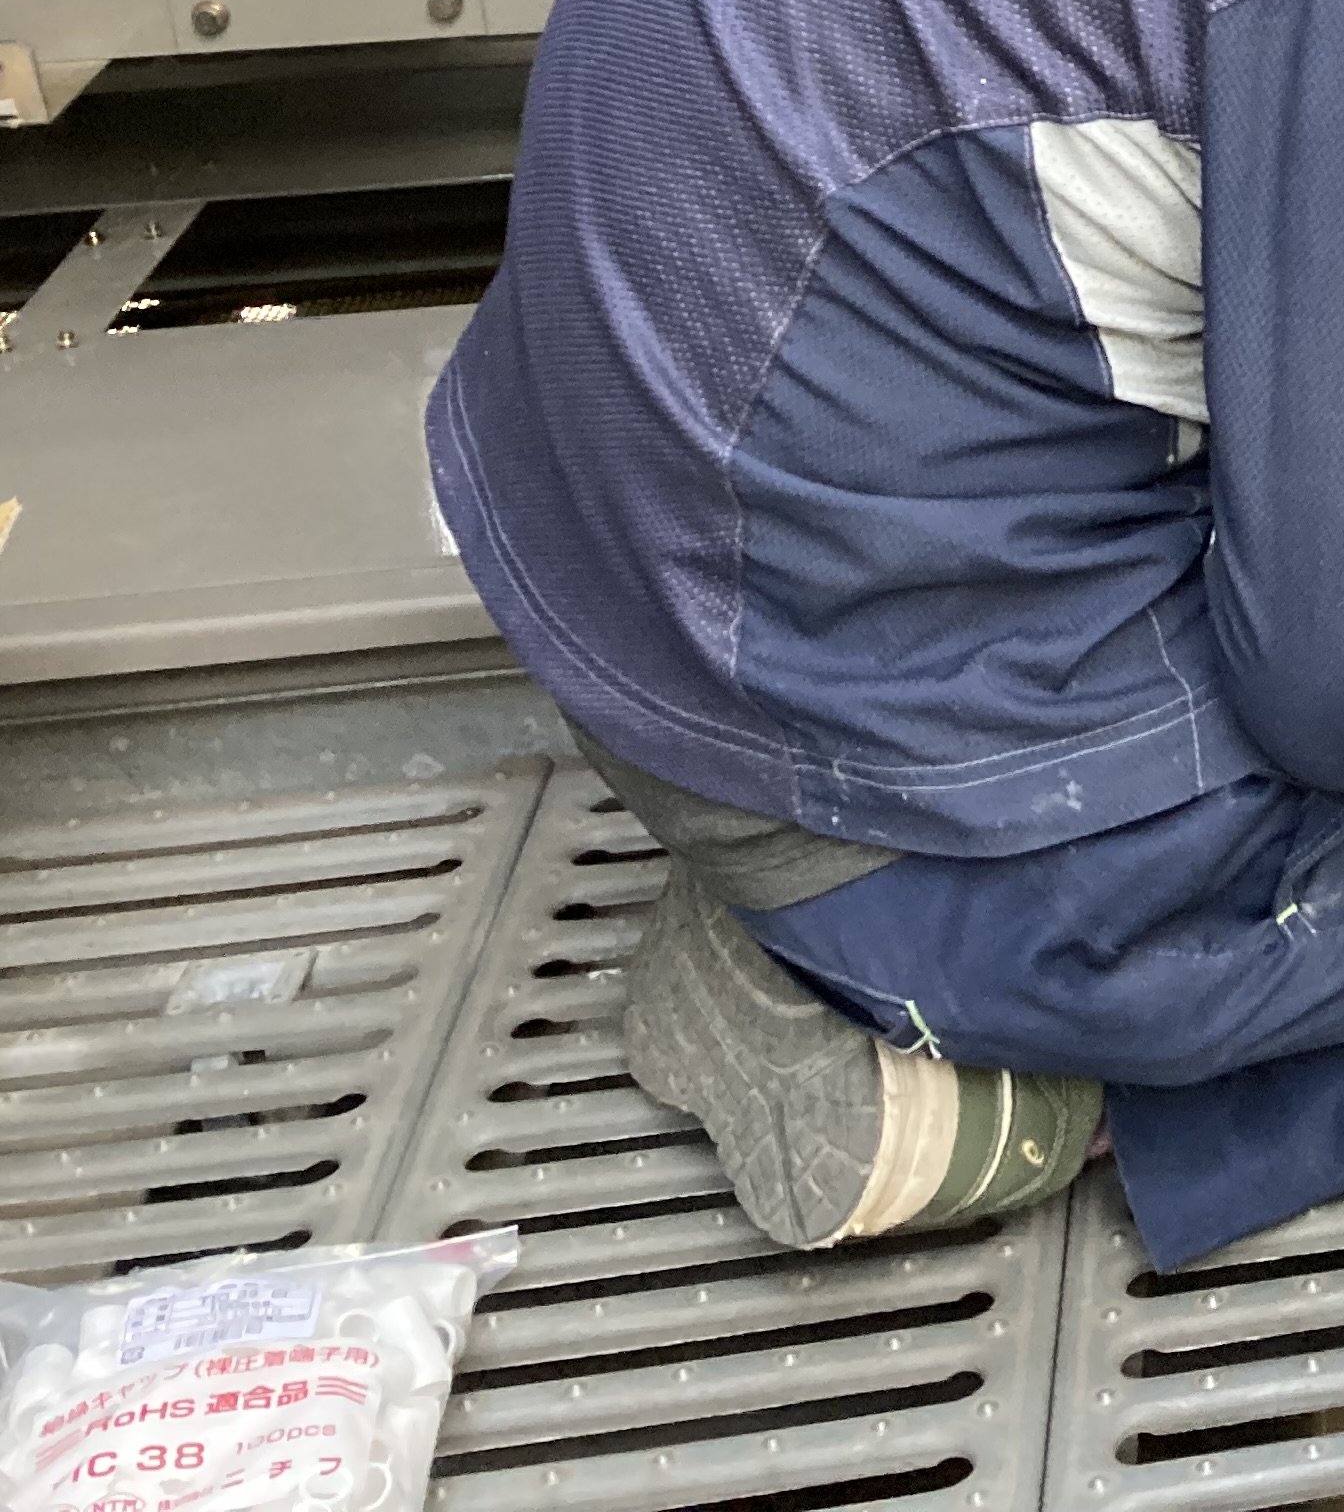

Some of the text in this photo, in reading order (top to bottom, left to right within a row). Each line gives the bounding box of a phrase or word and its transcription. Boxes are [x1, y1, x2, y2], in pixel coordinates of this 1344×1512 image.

[84, 1379, 310, 1438] RoHS 適合品
